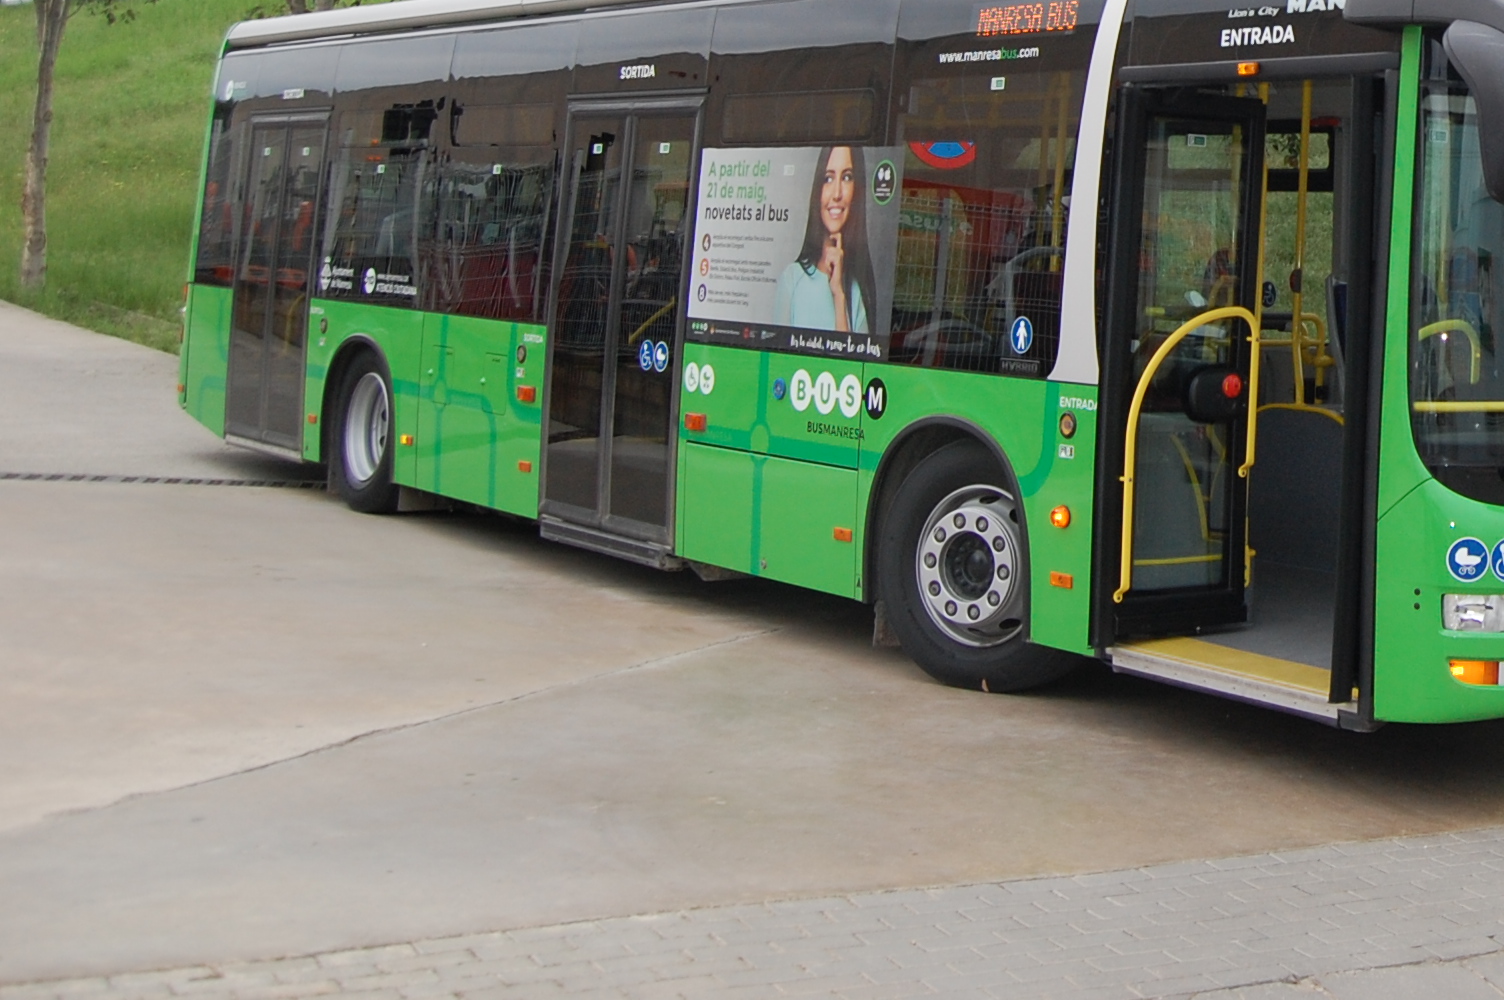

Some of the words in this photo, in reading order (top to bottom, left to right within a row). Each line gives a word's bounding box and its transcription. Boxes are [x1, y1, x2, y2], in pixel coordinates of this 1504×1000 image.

[976, 3, 1044, 36] MANRESA
[1046, 0, 1080, 31] BUS
[1258, 5, 1280, 18] City
[1220, 24, 1295, 48] ENTRADA
[939, 46, 1040, 64] www.manresabus.com
[620, 63, 656, 80] SORTIDA
[708, 161, 717, 177] A
[719, 160, 750, 181] partir
[752, 160, 771, 177] del
[706, 182, 718, 198] 21
[720, 182, 734, 198] de
[704, 204, 753, 221] novetats
[755, 204, 766, 221] al
[767, 204, 790, 222] bus
[806, 421, 866, 441] BUSMANRESA
